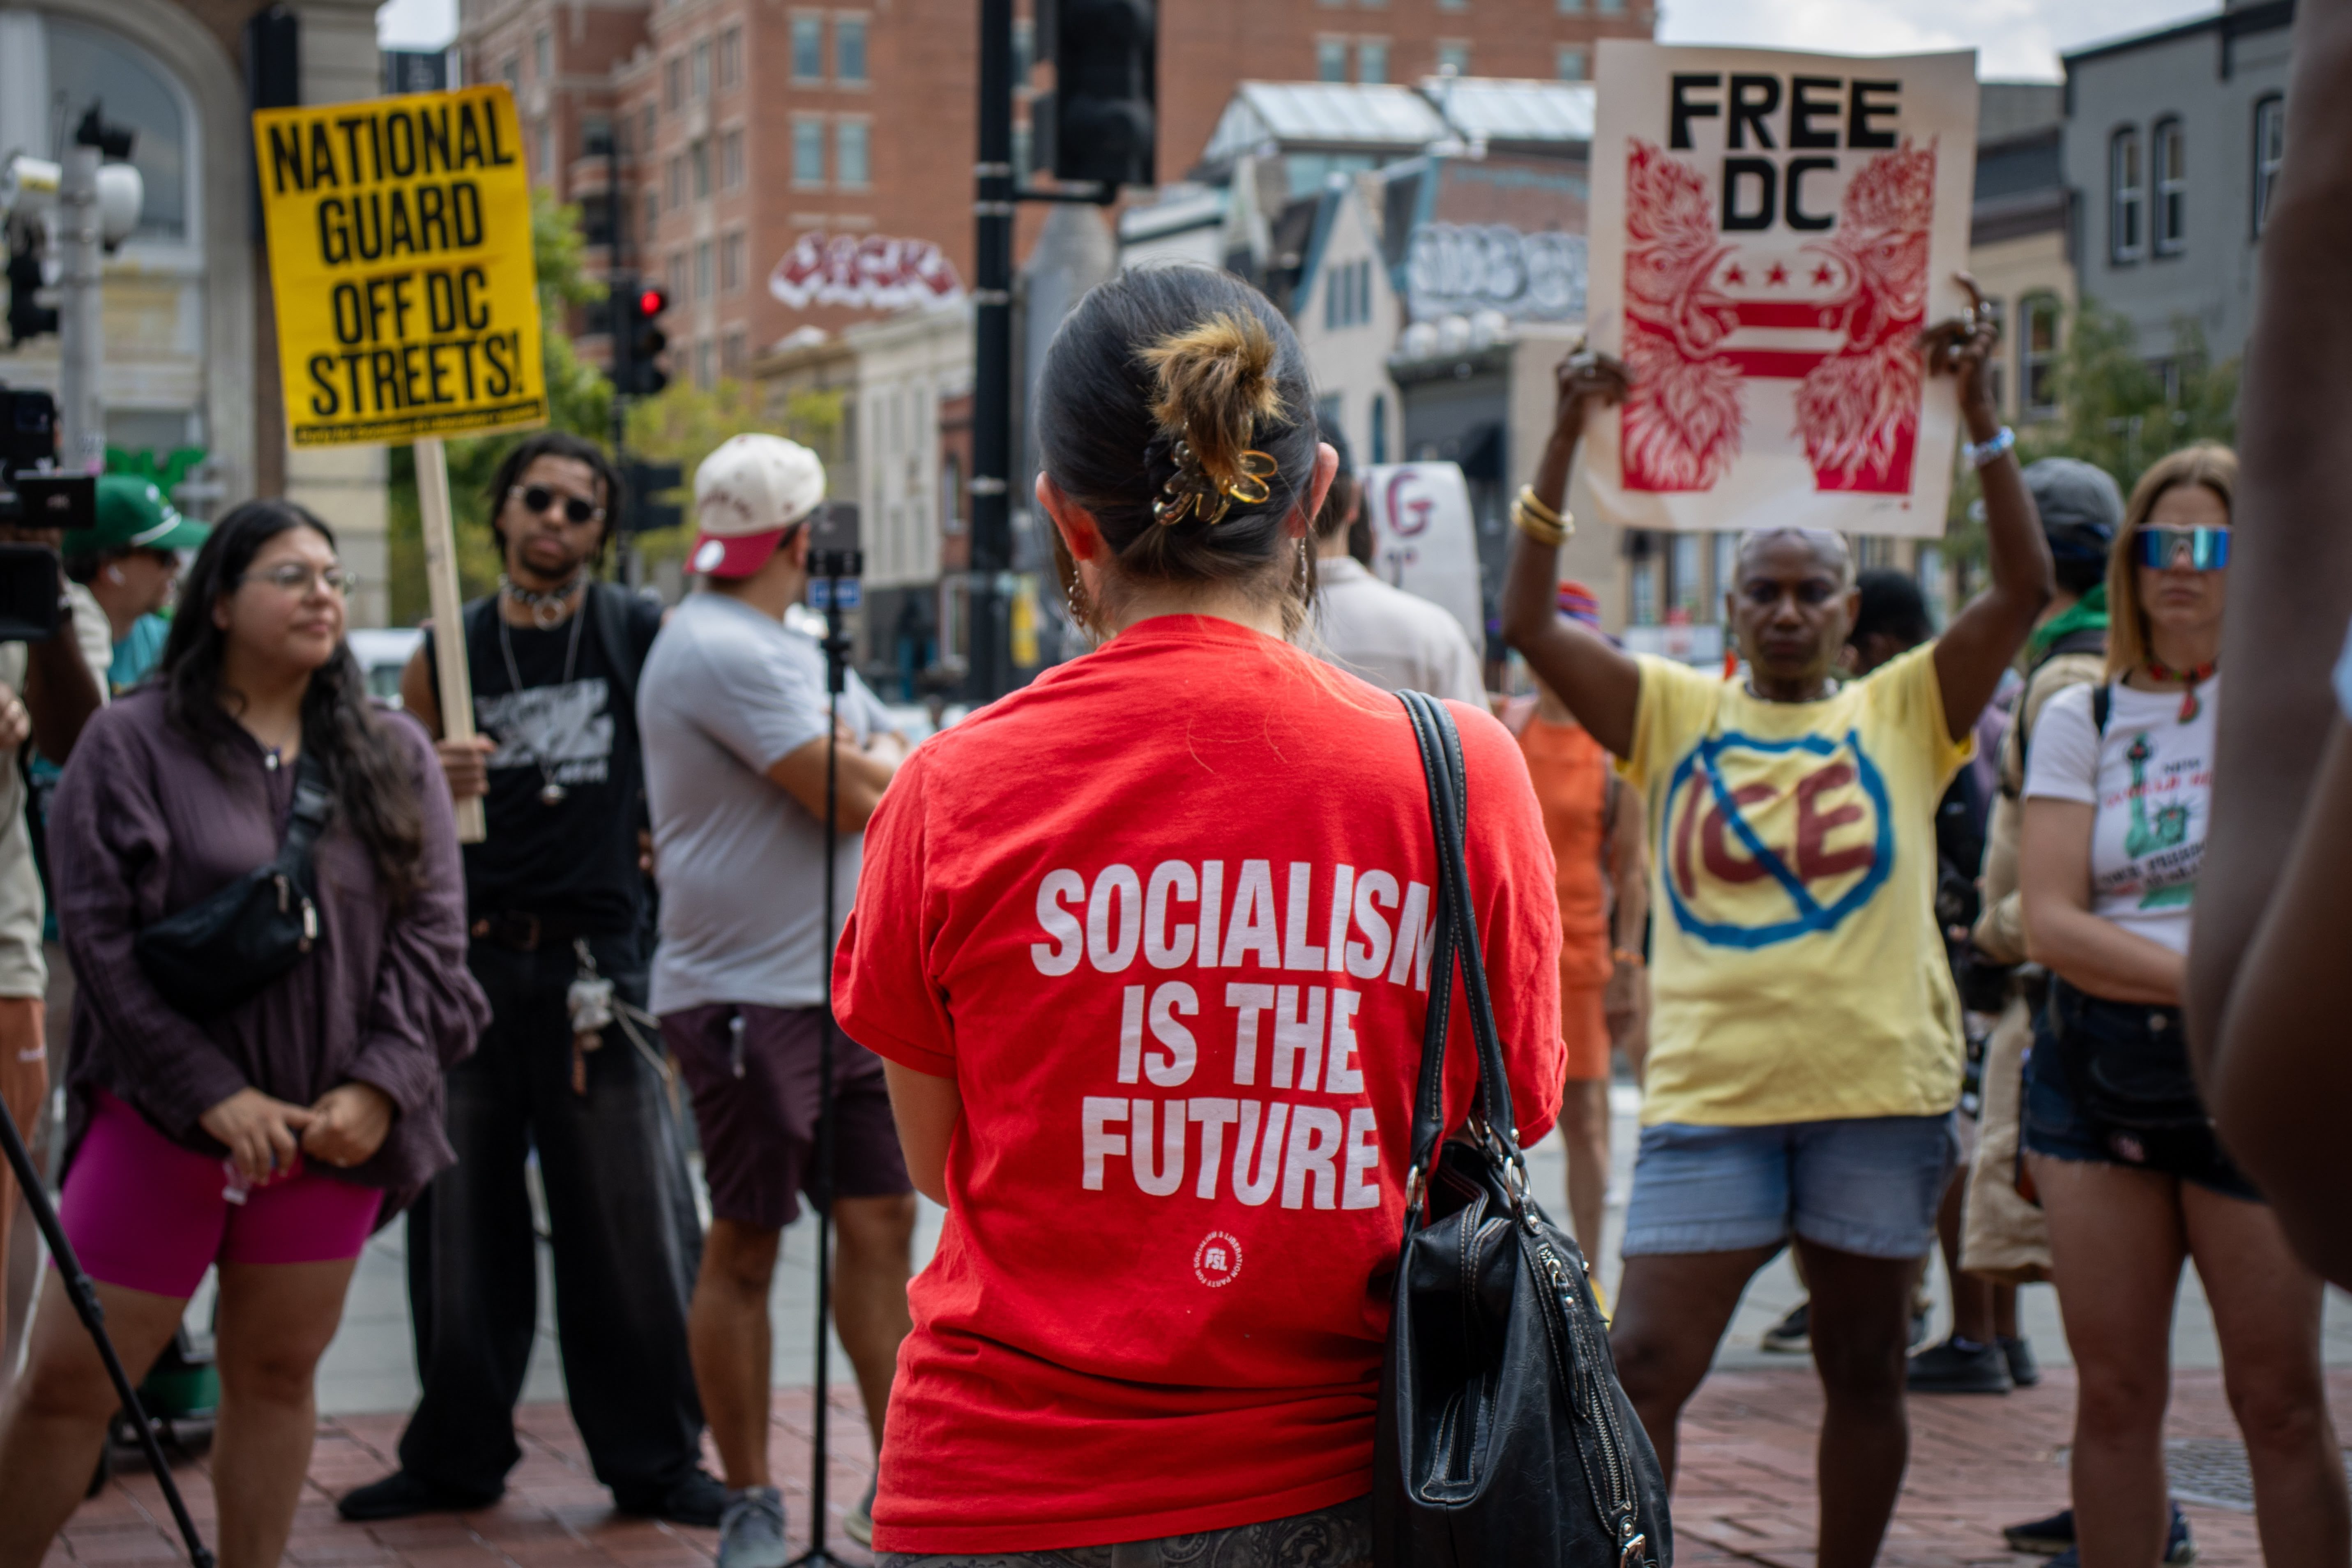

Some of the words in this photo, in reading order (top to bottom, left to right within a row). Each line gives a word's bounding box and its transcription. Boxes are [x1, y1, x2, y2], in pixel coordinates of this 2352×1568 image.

[269, 99, 514, 194] NATIONAL
[1670, 74, 1900, 149] FREE
[317, 182, 483, 267] GUARD
[1721, 157, 1837, 230] DC
[333, 274, 415, 344] OFF
[426, 266, 489, 333] DC
[309, 330, 523, 416] STREETS!
[1675, 763, 1877, 900] ICE
[1031, 859, 1437, 991] SOCIALISM
[1117, 981, 1199, 1087] IS
[1225, 982, 1364, 1094] THE
[1082, 1096, 1380, 1210] FUTURE
[1193, 1231, 1217, 1268] SOCIALISM
[1195, 1269, 1207, 1284] FOR
[1205, 1253, 1228, 1271] PSL
[1207, 1276, 1231, 1287] PARTY
[1224, 1233, 1243, 1278] LIBERATION
